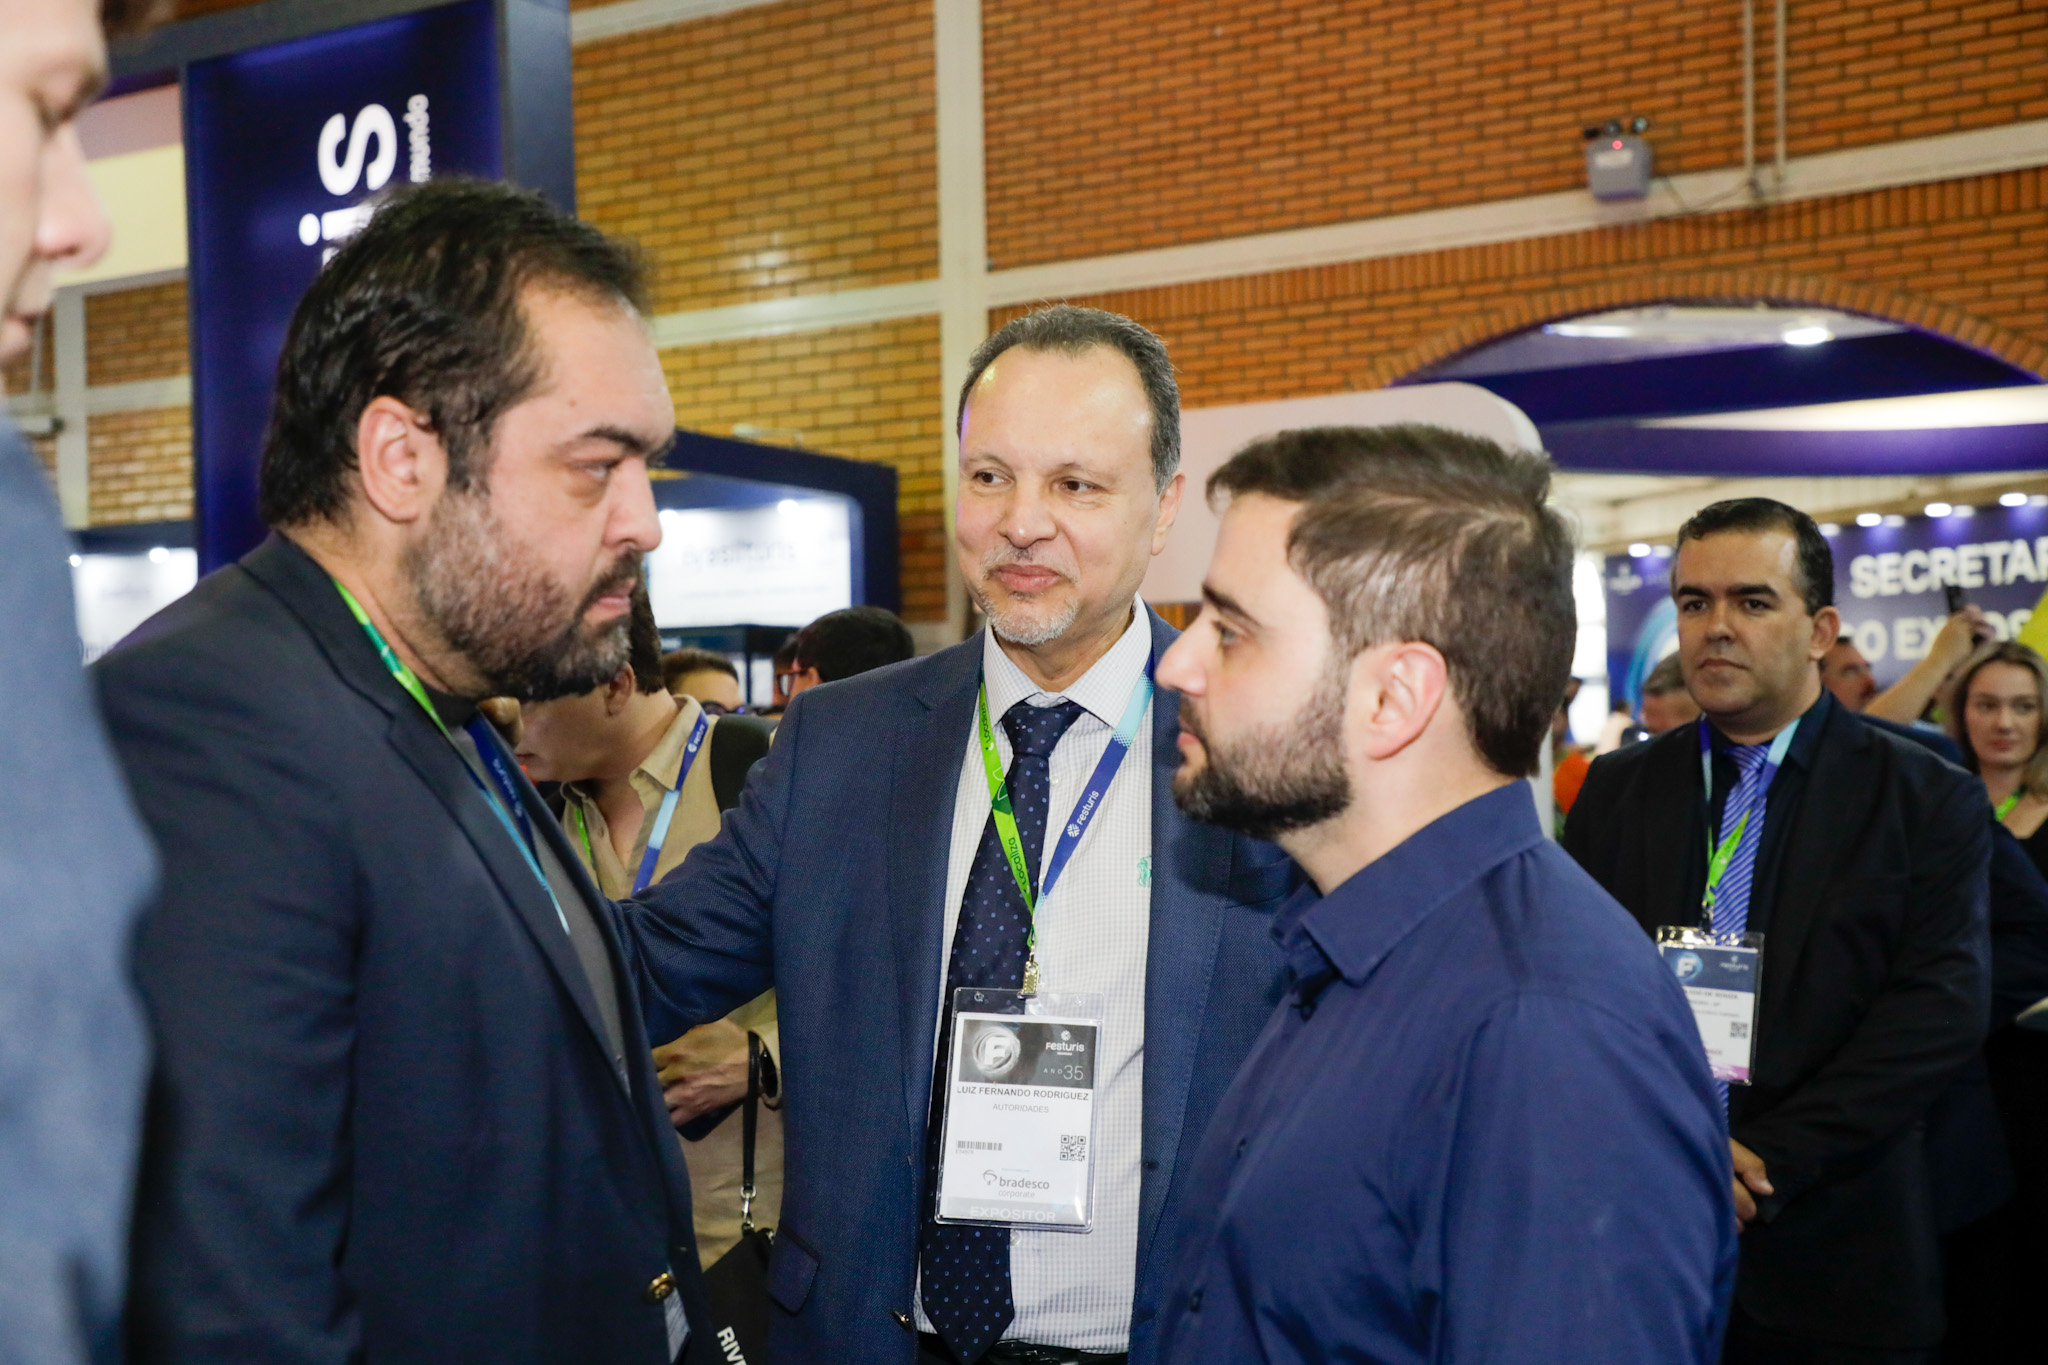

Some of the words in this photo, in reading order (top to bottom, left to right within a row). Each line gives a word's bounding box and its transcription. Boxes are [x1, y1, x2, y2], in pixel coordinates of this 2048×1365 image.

[1076, 790, 1099, 825] Festuris
[1045, 1041, 1085, 1052] Festuris
[1063, 1064, 1084, 1081] 35
[957, 1086, 977, 1094] LUIZ
[979, 1087, 1031, 1097] FERNANDO
[1033, 1090, 1089, 1100] RODRIGUEZ
[992, 1103, 1050, 1114] AUTORIDADES
[999, 1176, 1050, 1190] bradesco
[998, 1190, 1036, 1199] corporate
[970, 1206, 1056, 1223] EXPOSITOR
